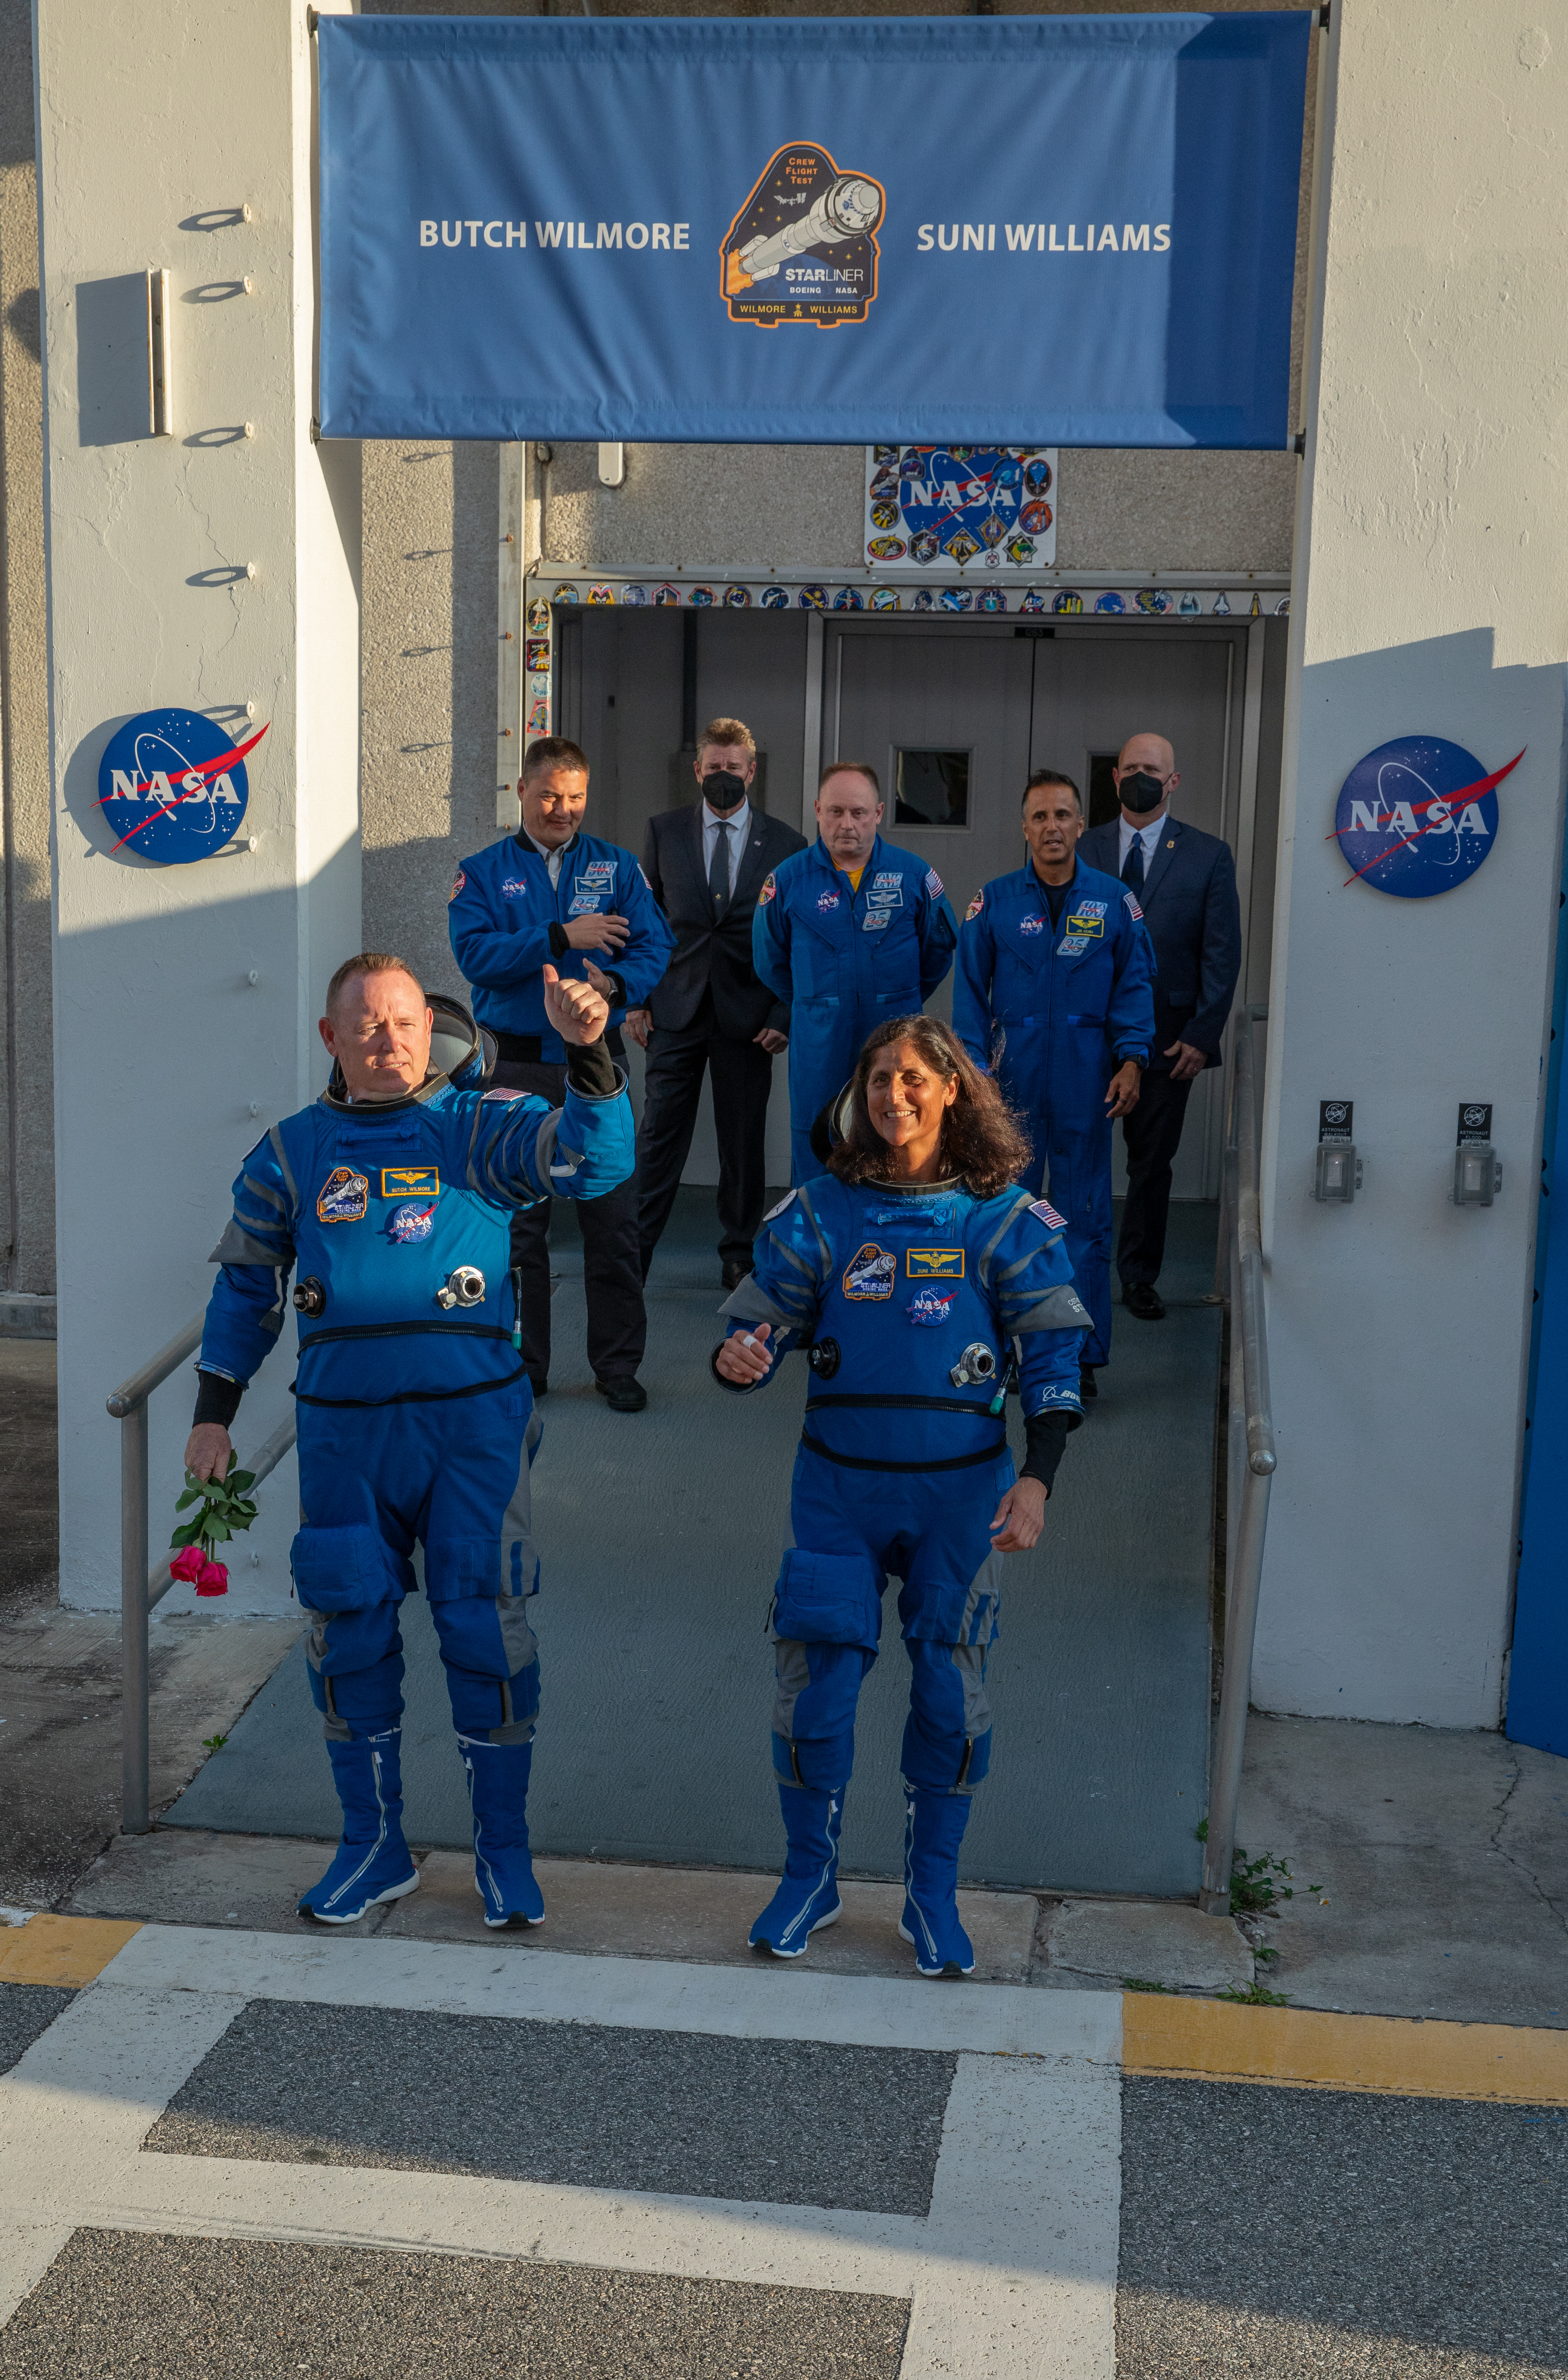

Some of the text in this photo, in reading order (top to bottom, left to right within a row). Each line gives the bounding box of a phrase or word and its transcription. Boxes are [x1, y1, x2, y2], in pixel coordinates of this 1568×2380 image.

[420, 220, 690, 250] BUTCH WILMORE
[917, 224, 1171, 251] SUNI WILLIAMS
[785, 268, 864, 282] STARLINER
[740, 305, 786, 313] WILMORE
[810, 306, 857, 314] WILLIAMS
[910, 480, 1016, 507] NASA
[110, 770, 242, 804] NASA
[1347, 800, 1490, 835] NASA
[817, 897, 839, 906] NASA
[396, 1216, 432, 1228] NASA
[914, 1300, 950, 1311] NASA
